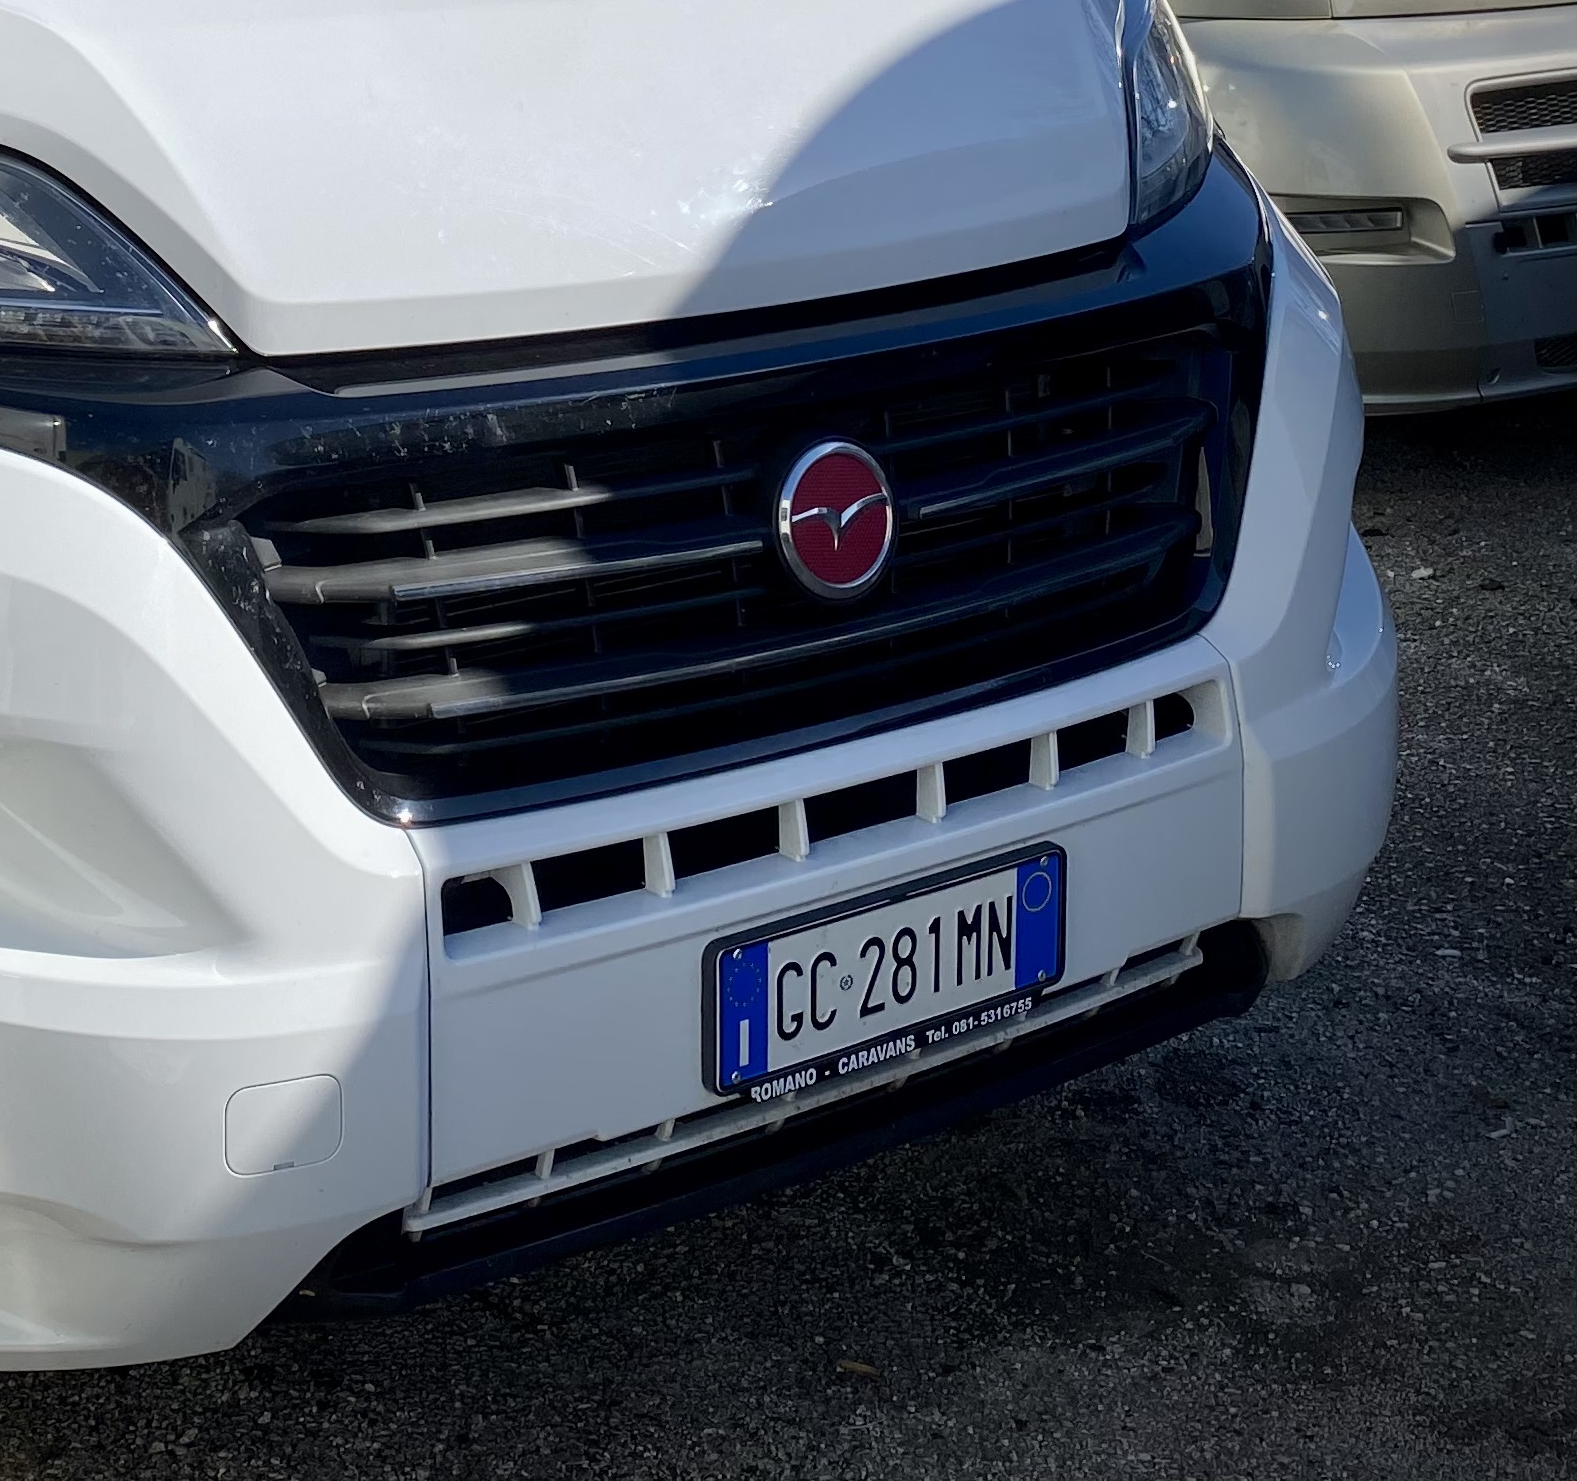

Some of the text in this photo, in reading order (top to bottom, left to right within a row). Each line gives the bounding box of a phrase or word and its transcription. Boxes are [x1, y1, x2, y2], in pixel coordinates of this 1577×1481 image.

[750, 1068, 818, 1103] ROMANO
[837, 1034, 916, 1075] CARAVANS
[926, 1028, 949, 1045] Tel.
